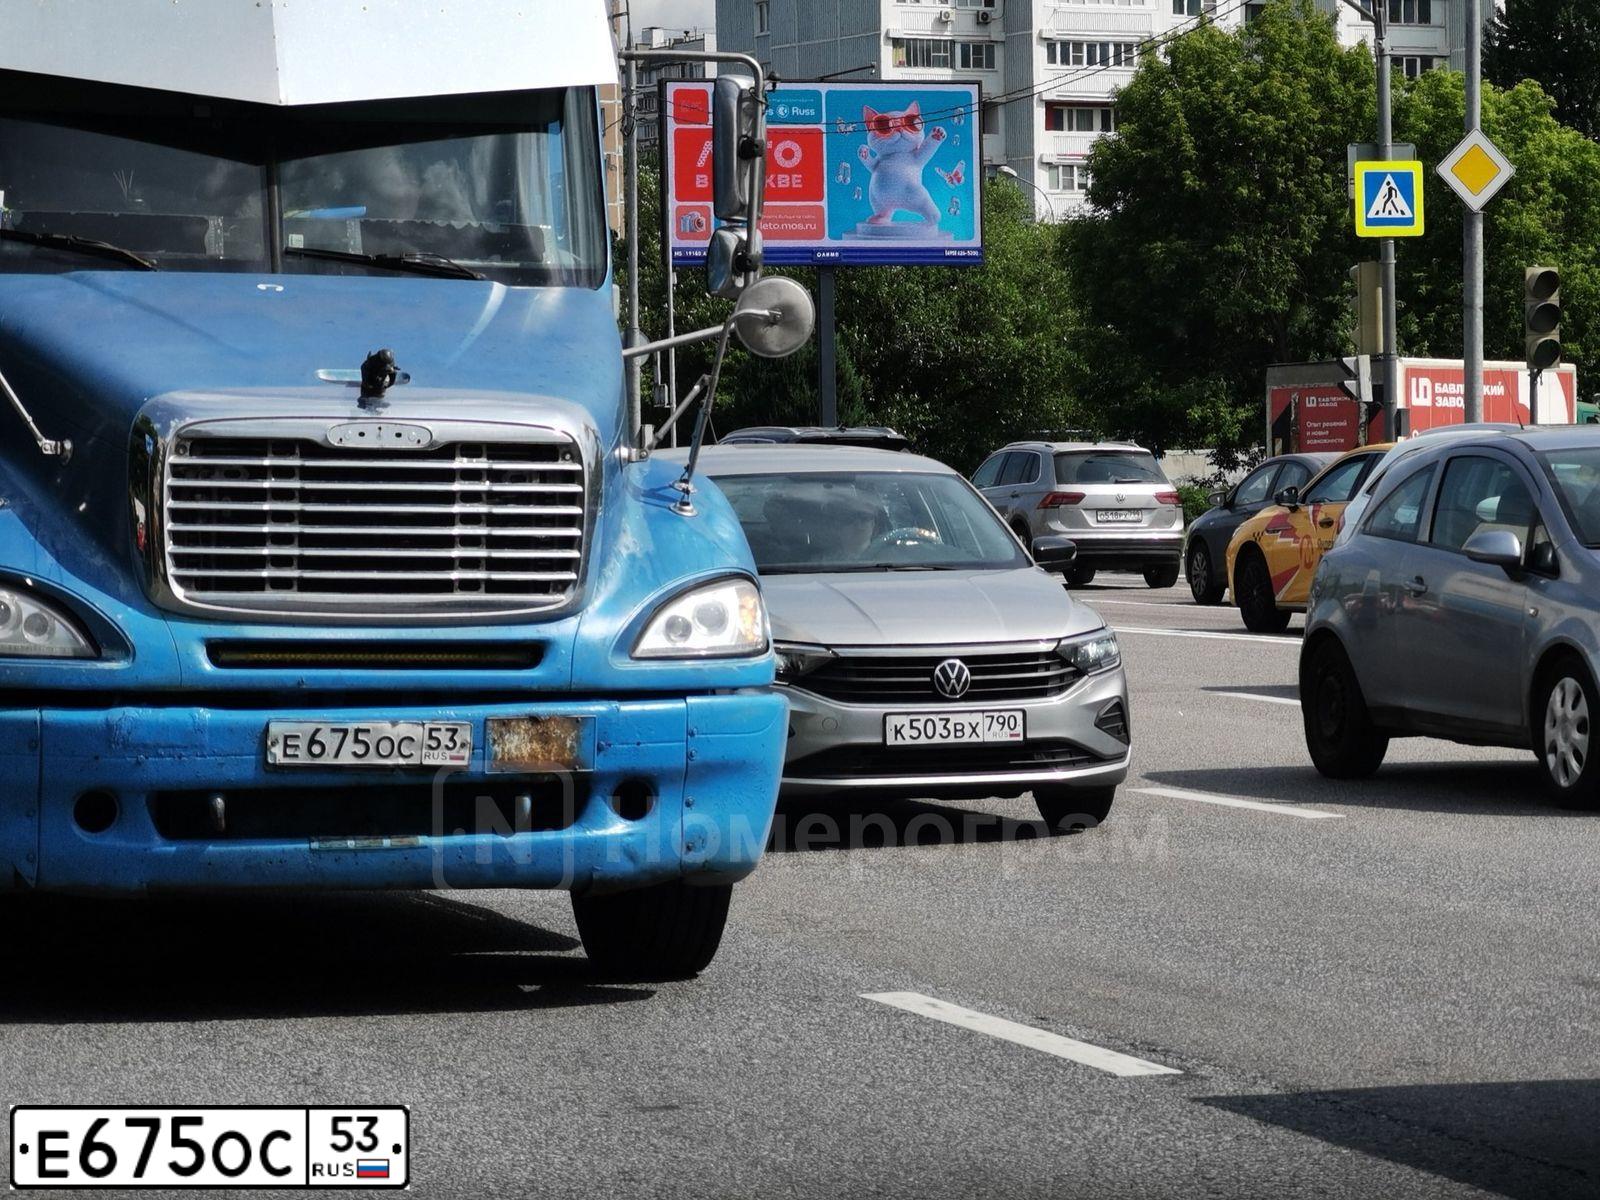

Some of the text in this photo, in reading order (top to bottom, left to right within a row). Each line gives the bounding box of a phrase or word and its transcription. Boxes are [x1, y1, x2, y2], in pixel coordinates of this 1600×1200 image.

[792, 106, 816, 116] Russ
[760, 221, 817, 231] leto.mos.ru
[893, 714, 1018, 742] К503ВХ 790
[282, 727, 459, 760] Е675ОС 53
[423, 751, 448, 761] RUS
